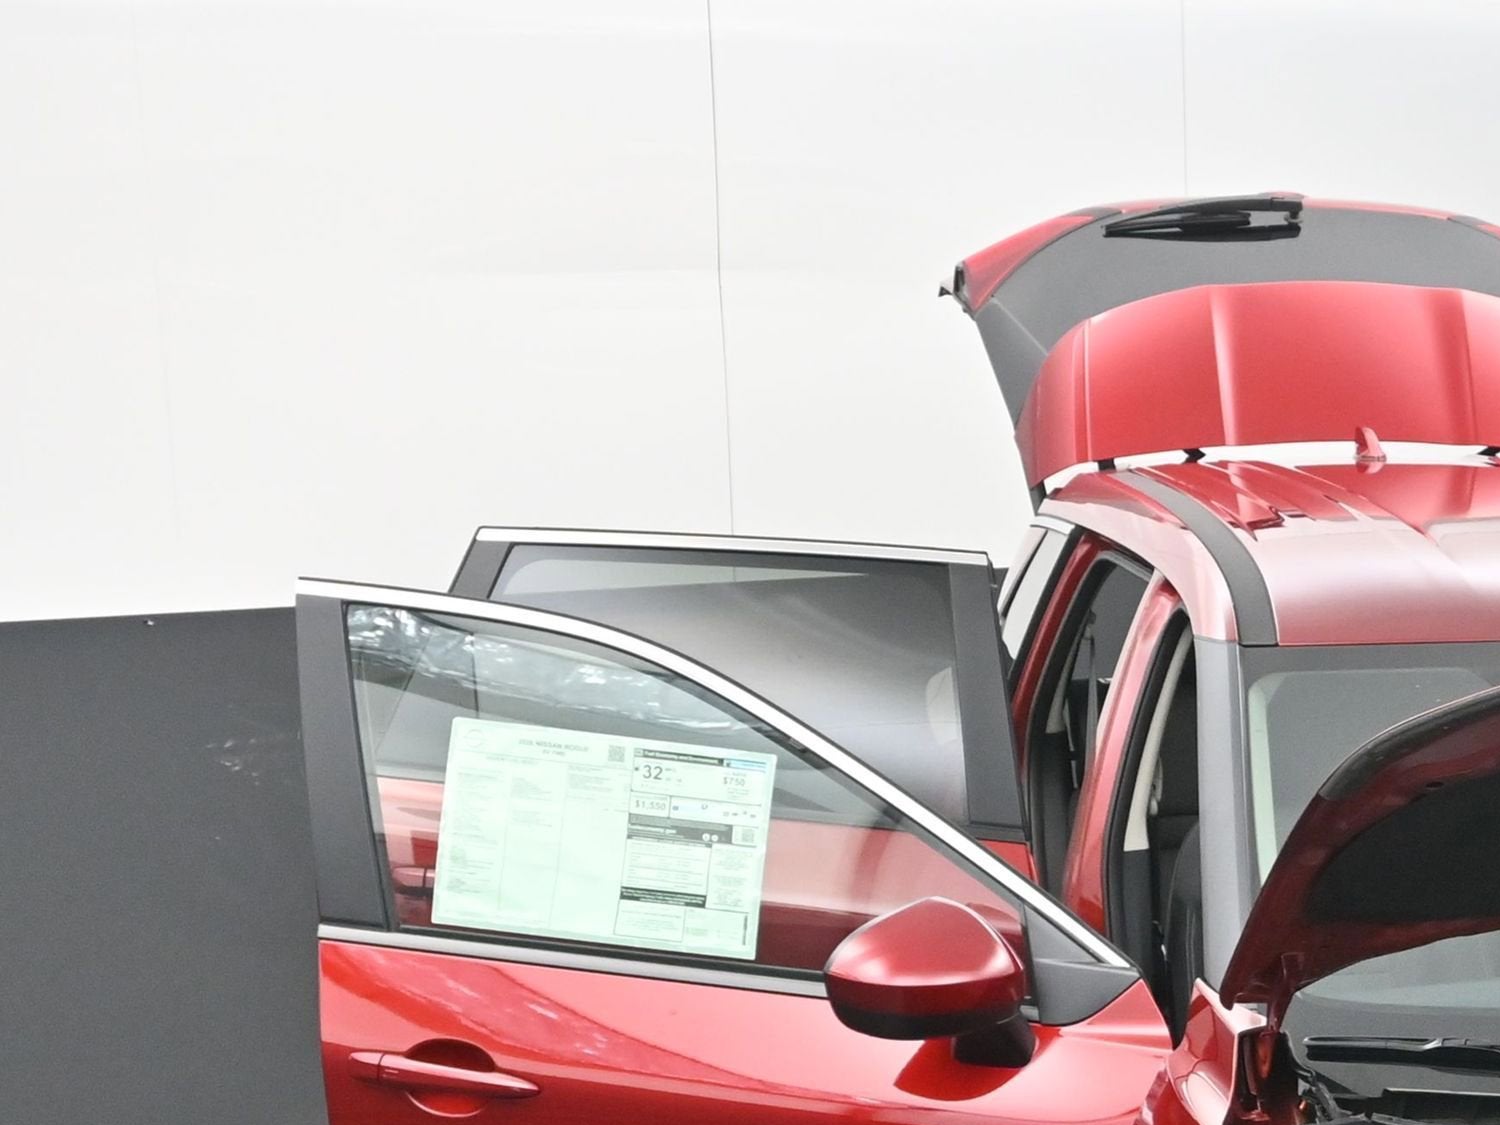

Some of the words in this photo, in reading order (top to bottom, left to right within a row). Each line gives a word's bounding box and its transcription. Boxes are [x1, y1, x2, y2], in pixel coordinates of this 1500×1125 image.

[642, 764, 663, 780] 32
[723, 776, 746, 787] $750
[635, 799, 666, 811] $1,550
